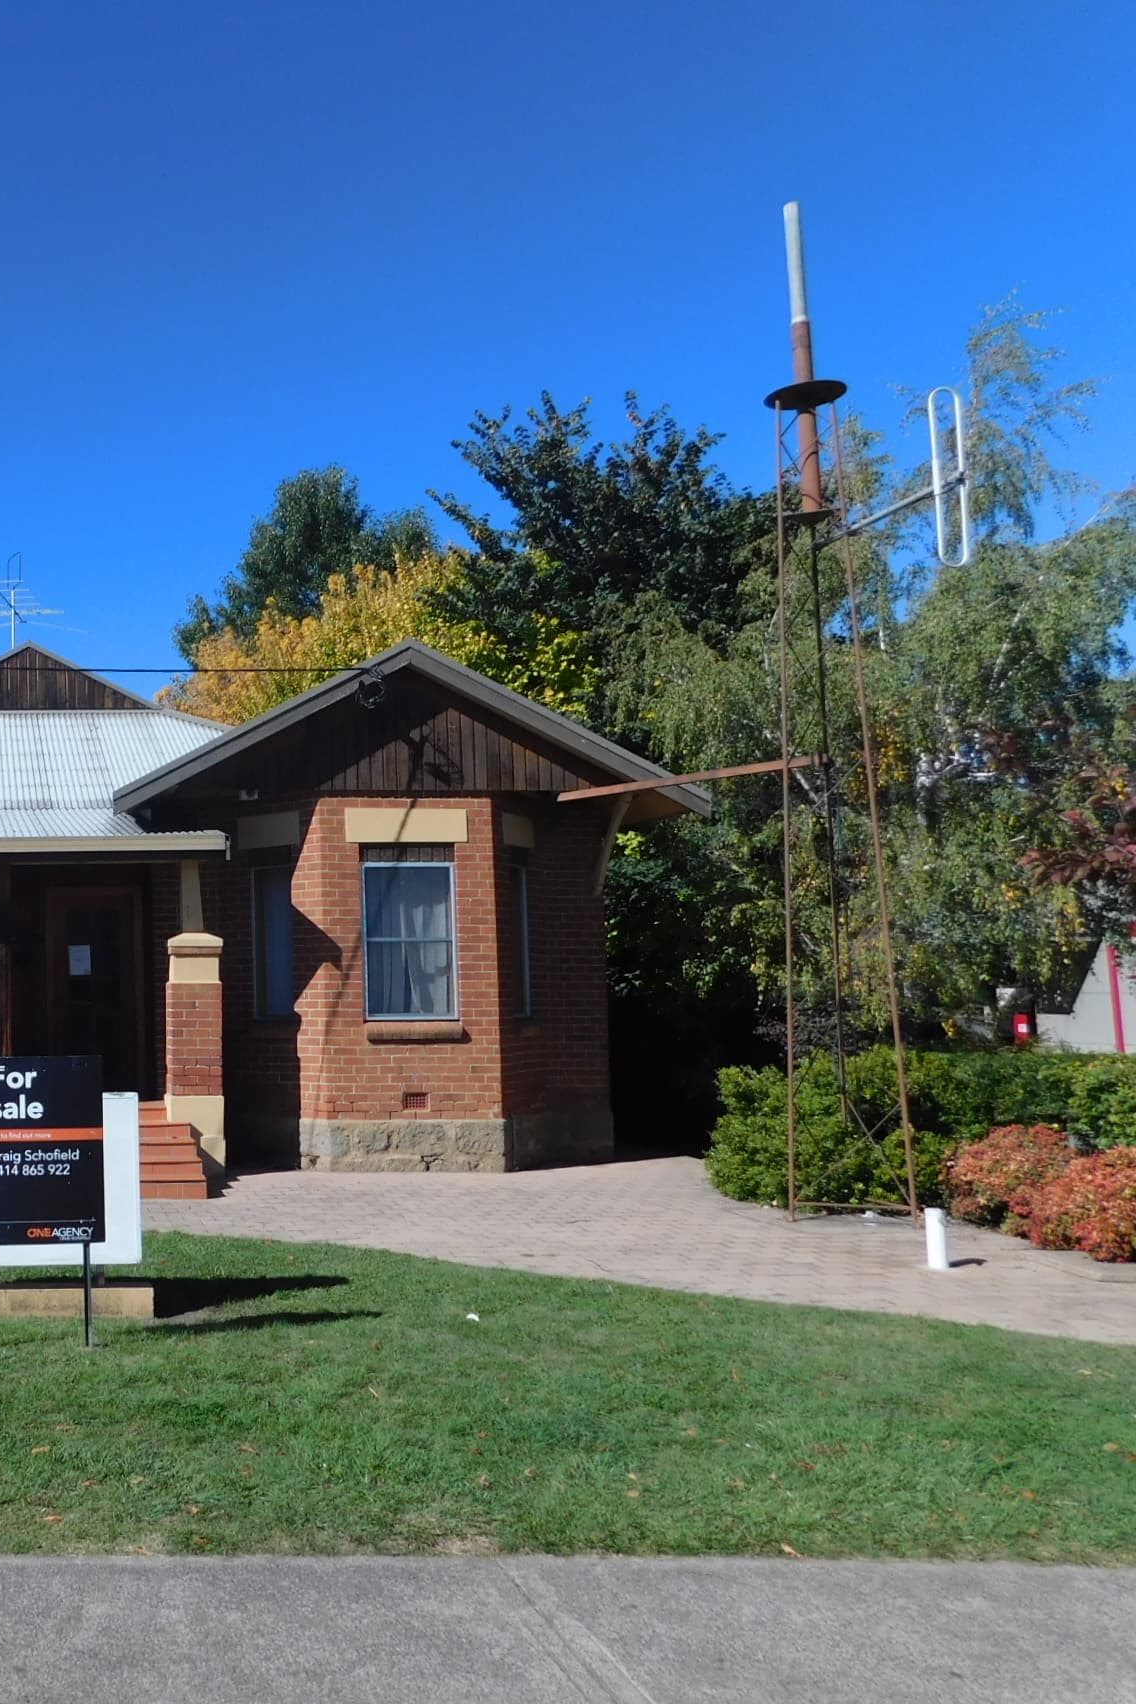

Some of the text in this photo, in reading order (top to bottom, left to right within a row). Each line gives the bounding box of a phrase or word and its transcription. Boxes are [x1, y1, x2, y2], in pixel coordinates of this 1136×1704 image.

[24, 1148, 80, 1161] Schofield
[22, 1163, 45, 1176] 865
[47, 1163, 71, 1175] 922
